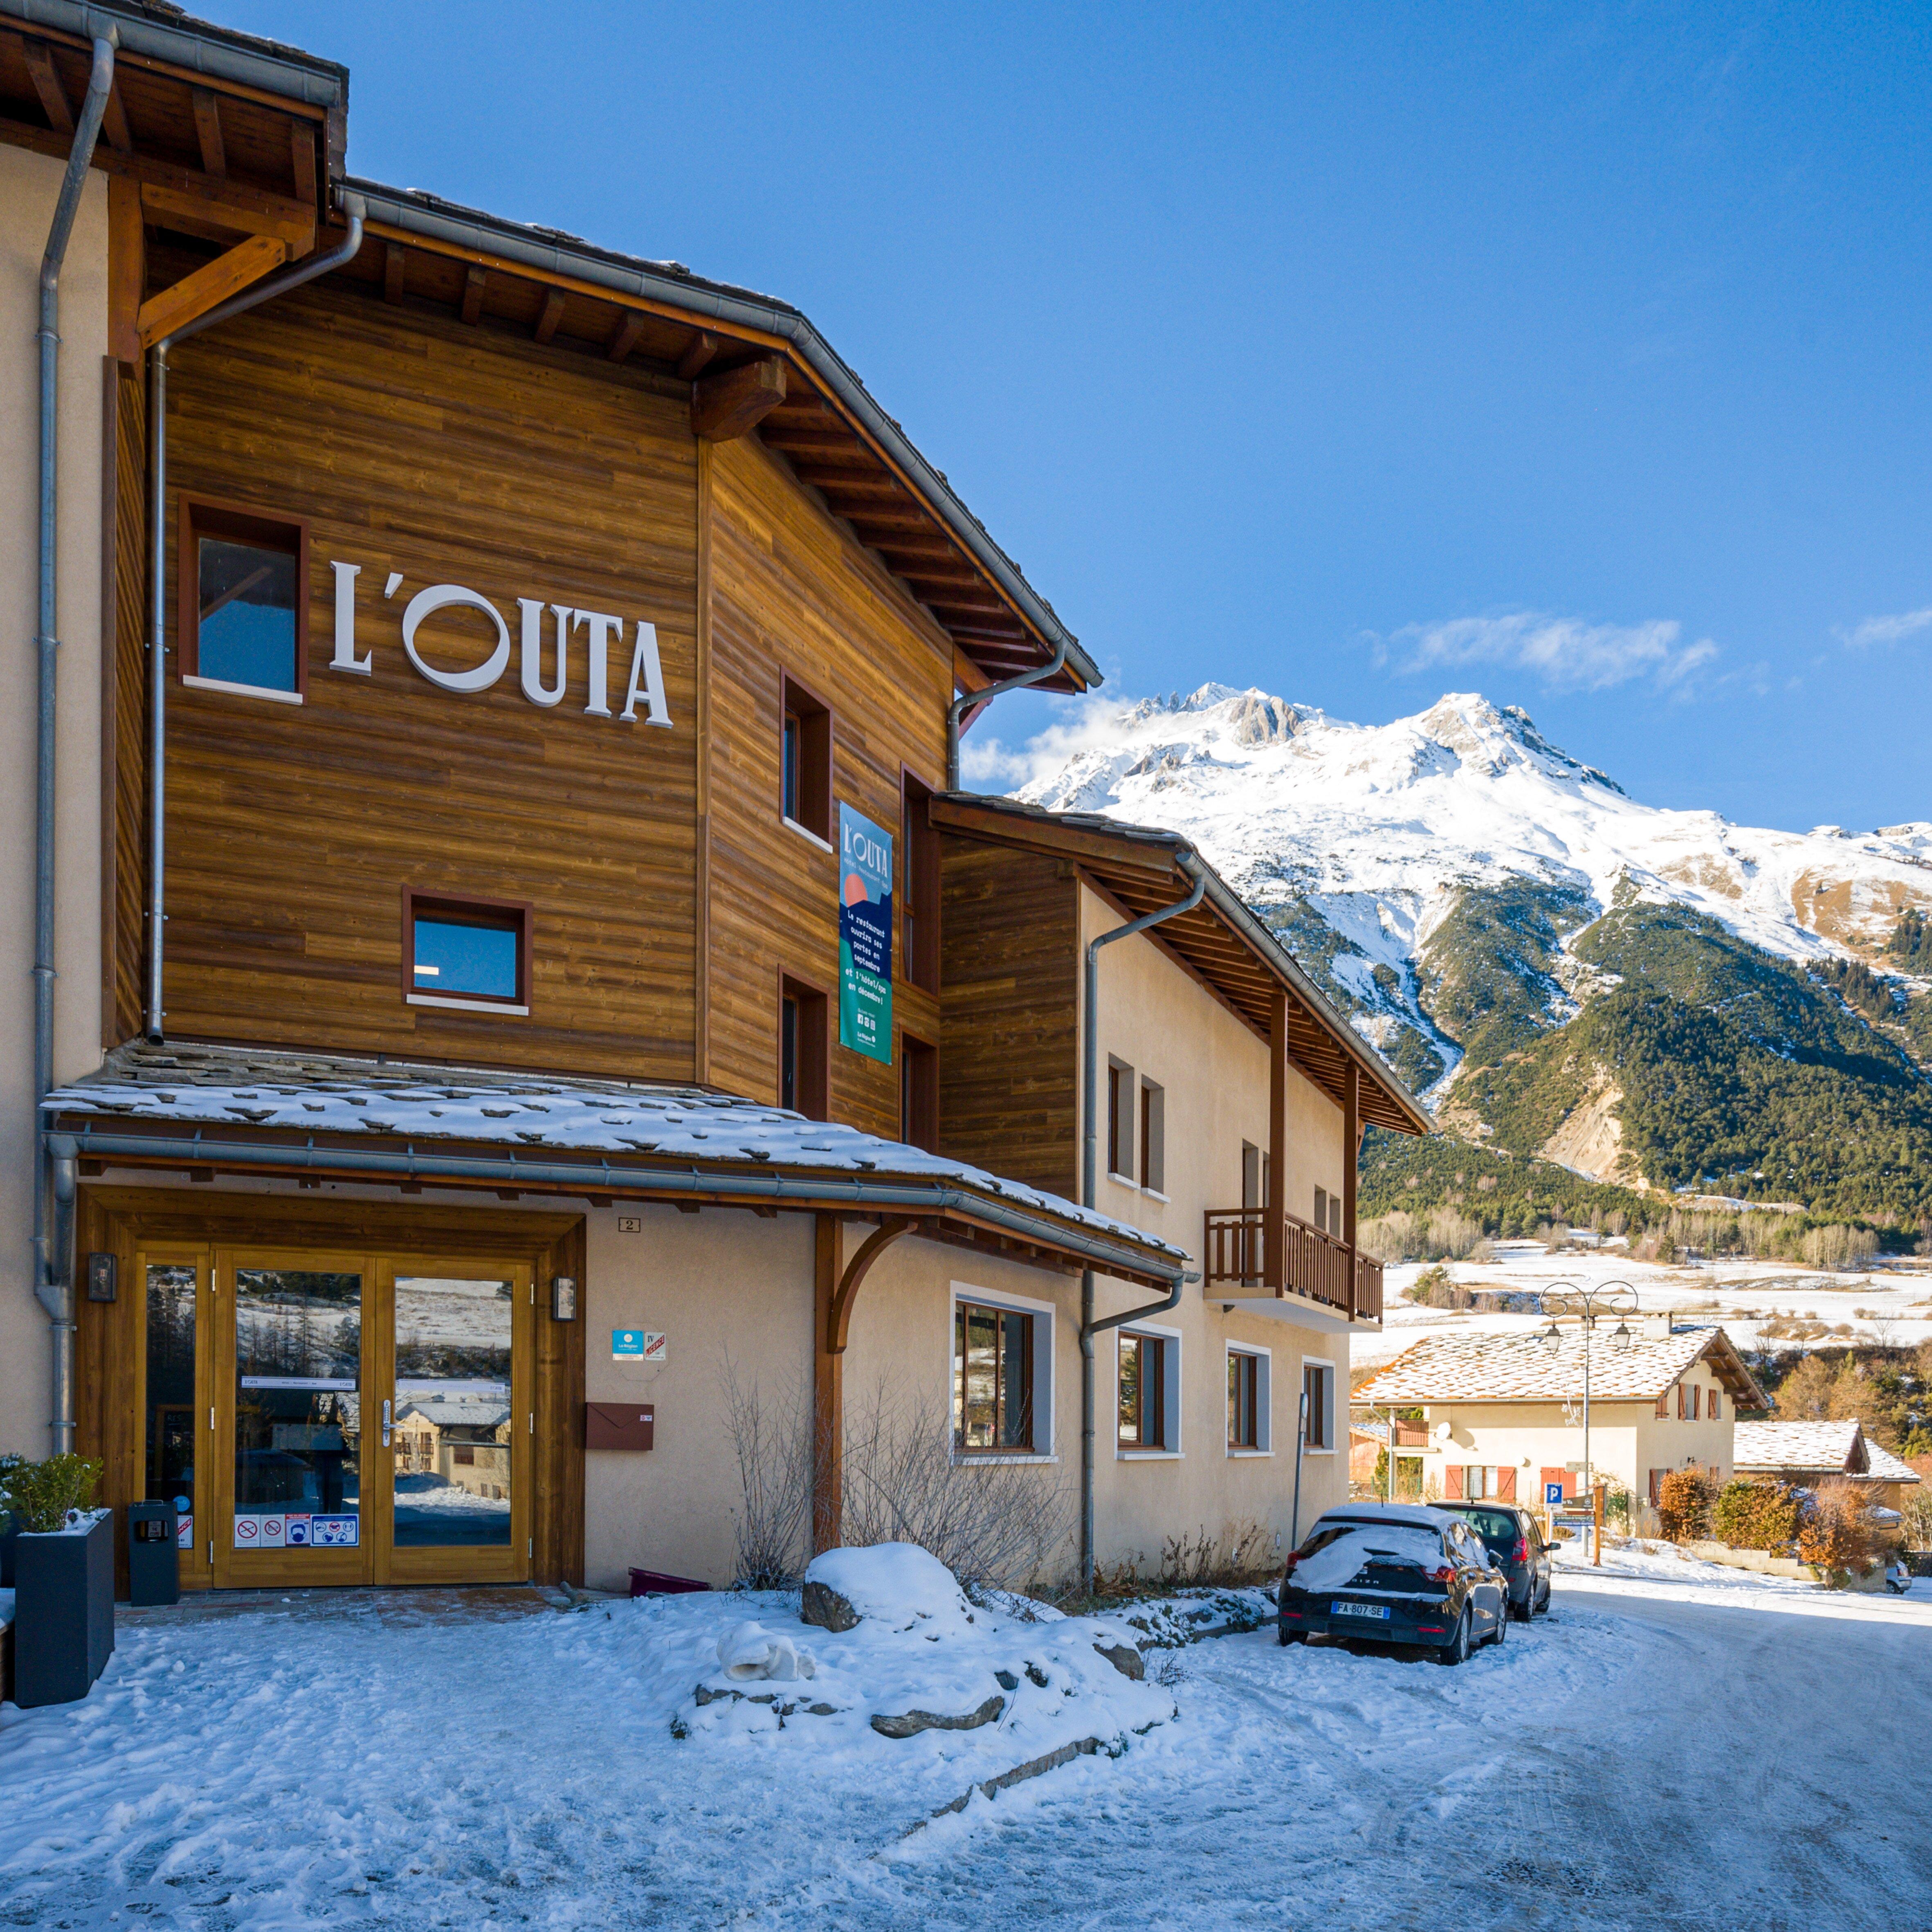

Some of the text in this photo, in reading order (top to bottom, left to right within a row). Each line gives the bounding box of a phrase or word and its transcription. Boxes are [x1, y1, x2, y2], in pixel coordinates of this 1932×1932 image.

[330, 561, 674, 728] L'OUTA
[845, 823, 887, 878] L'OUTA
[848, 910, 885, 938] Le restaurant
[851, 927, 882, 949] ouvrira ses
[854, 941, 871, 955] portes
[854, 954, 880, 973] septembre
[845, 968, 853, 977] et
[848, 983, 856, 991] en
[626, 1220, 633, 1230] 2
[646, 1335, 665, 1357] LICENCE
[1550, 1487, 1558, 1501] P
[1338, 1604, 1382, 1616] FA-807-SE
